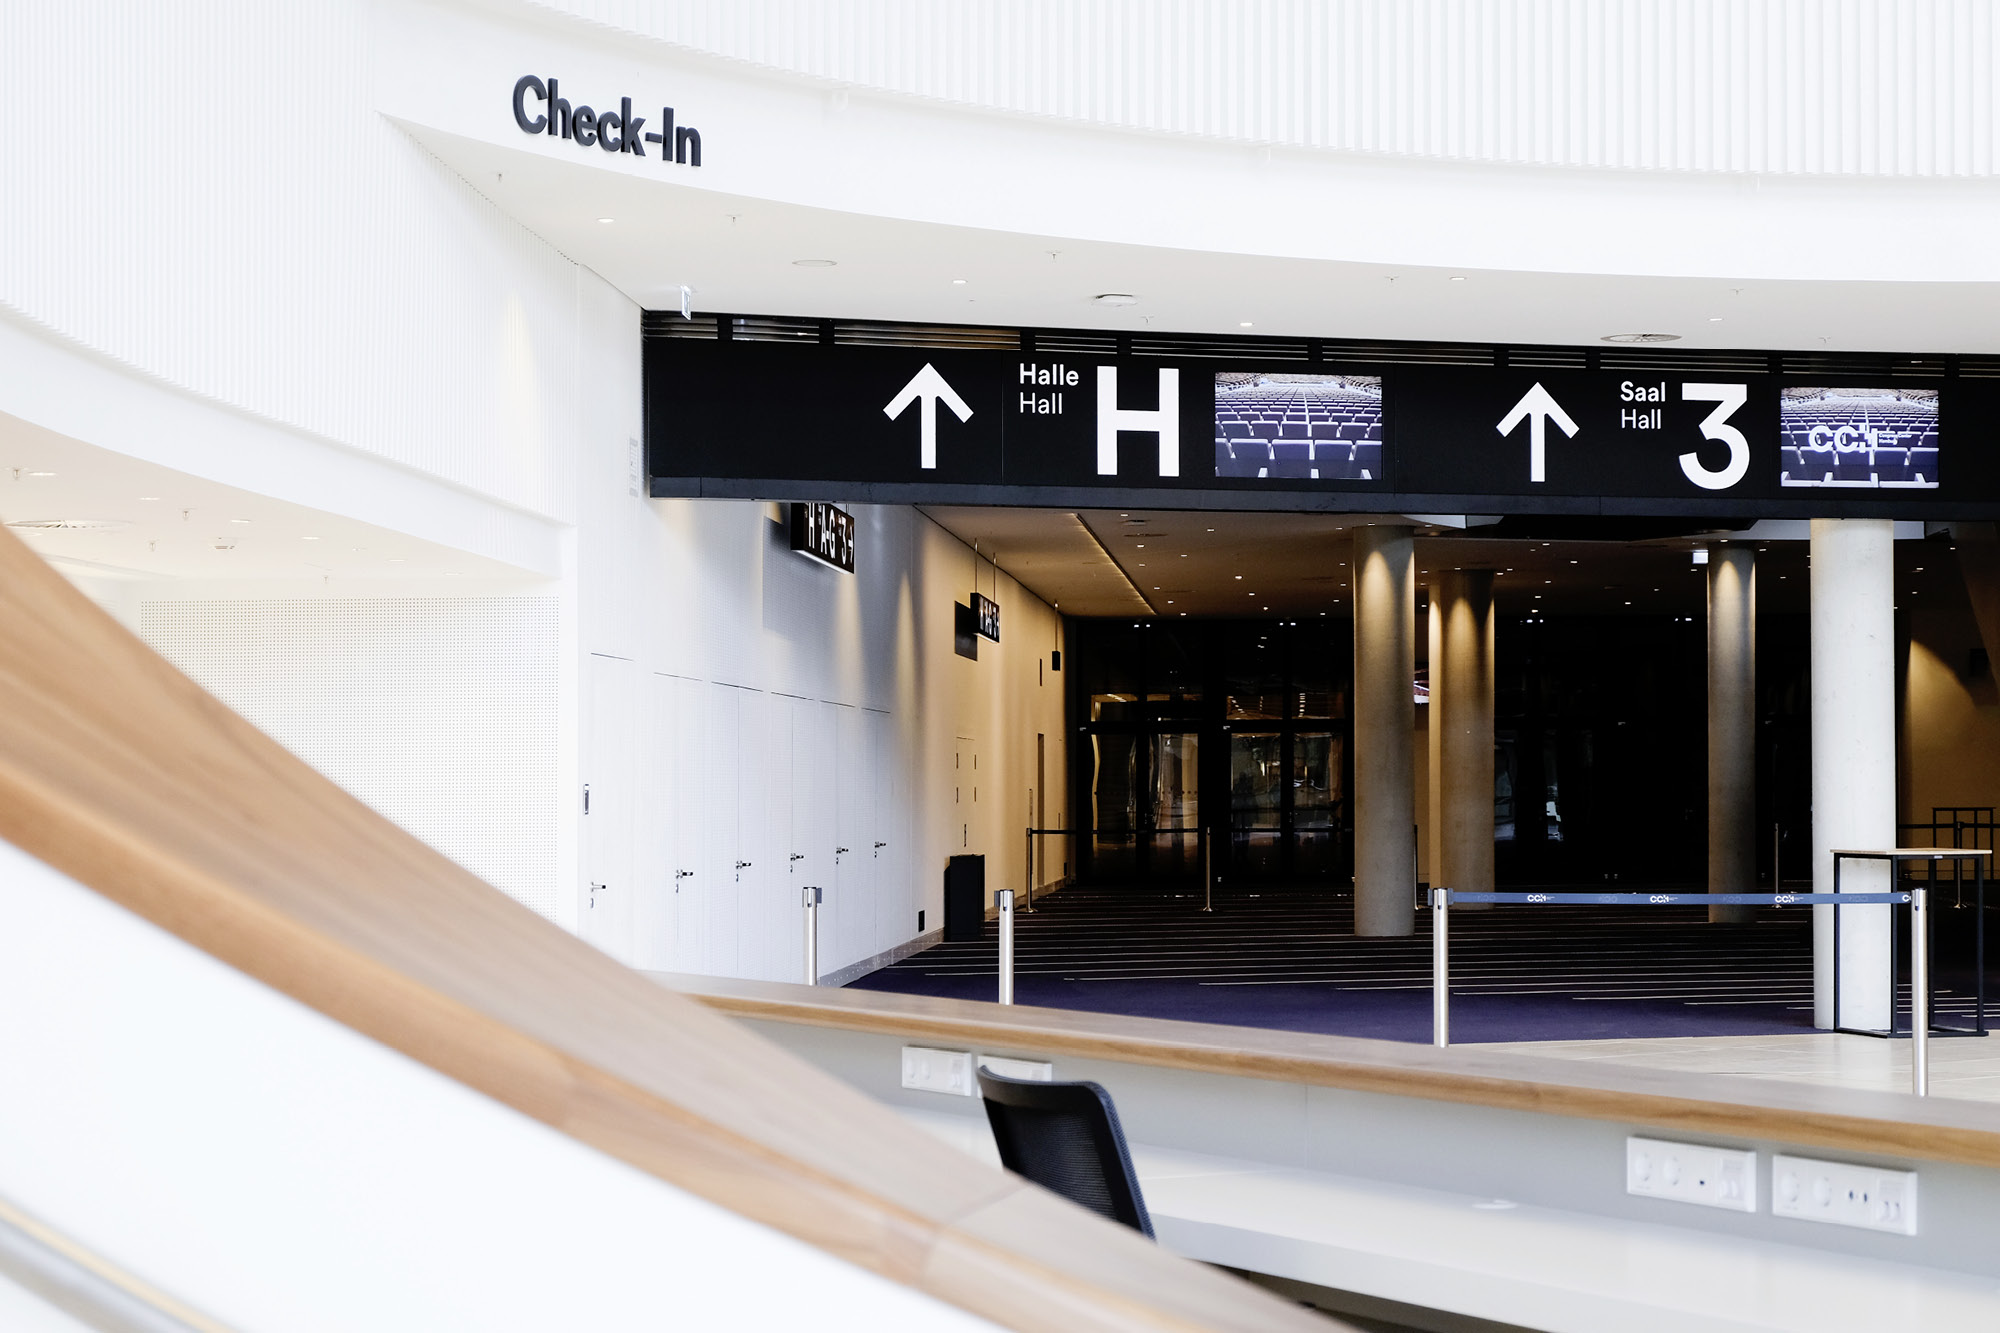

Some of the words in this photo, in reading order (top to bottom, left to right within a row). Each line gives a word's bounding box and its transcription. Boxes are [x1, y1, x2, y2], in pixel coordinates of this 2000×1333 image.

[513, 75, 701, 167] Check-In
[1019, 363, 1079, 386] Halle
[1620, 381, 1666, 402] Saal
[1019, 392, 1063, 415] Hall
[1097, 366, 1179, 477] H
[1621, 409, 1662, 430] Hall
[1679, 383, 1750, 490] 3
[808, 502, 815, 549] H
[820, 504, 836, 559] A-G
[841, 516, 847, 565] 3
